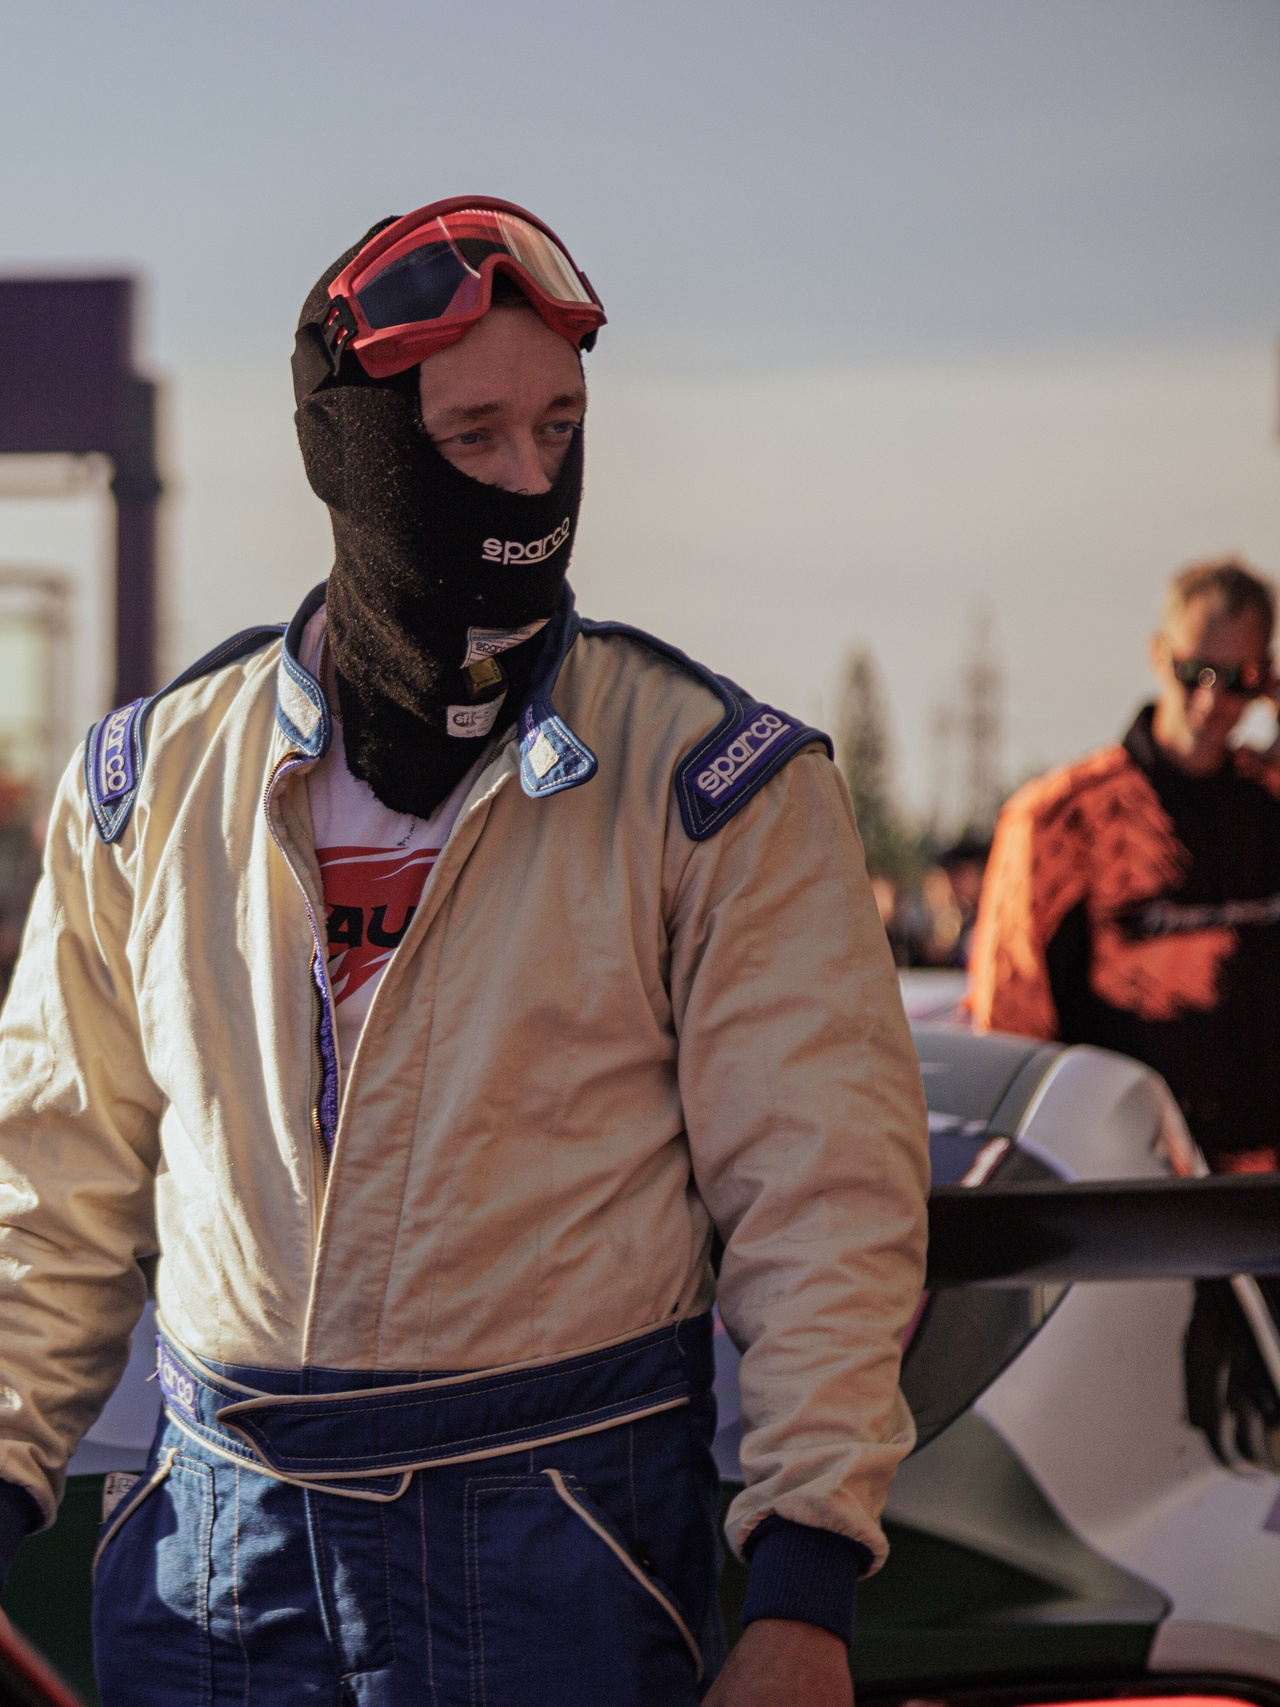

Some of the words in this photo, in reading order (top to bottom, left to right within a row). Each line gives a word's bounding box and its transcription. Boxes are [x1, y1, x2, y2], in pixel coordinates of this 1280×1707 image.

[483, 517, 570, 565] sparco
[107, 706, 135, 791] sparco
[697, 714, 783, 787] sparco
